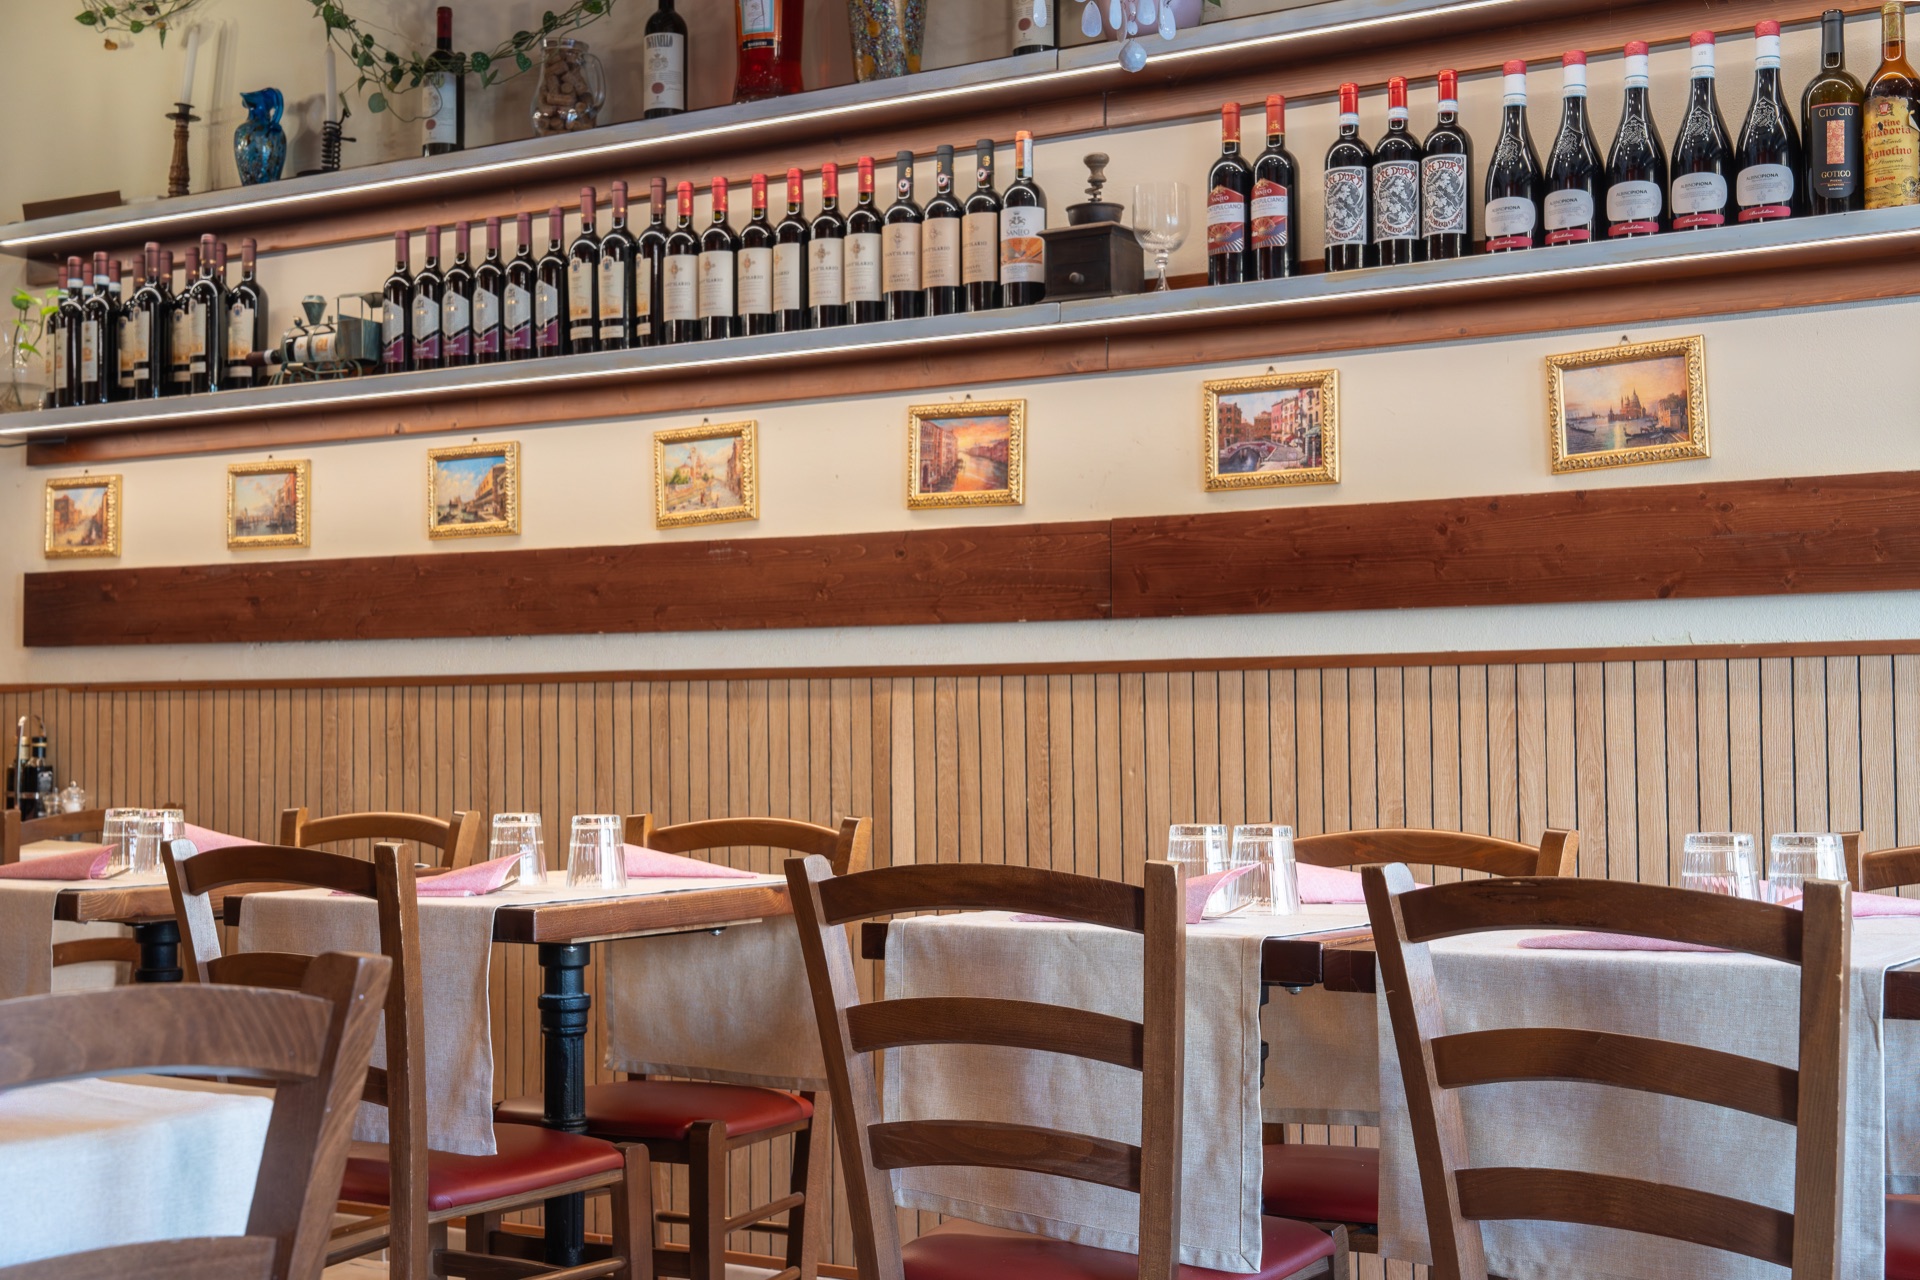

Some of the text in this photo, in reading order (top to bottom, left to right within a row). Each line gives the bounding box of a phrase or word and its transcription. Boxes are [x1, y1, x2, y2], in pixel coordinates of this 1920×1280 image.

[1818, 106, 1854, 118] CIÙ CIÙ
[1871, 119, 1901, 129] catine
[1821, 169, 1851, 178] GOTICO
